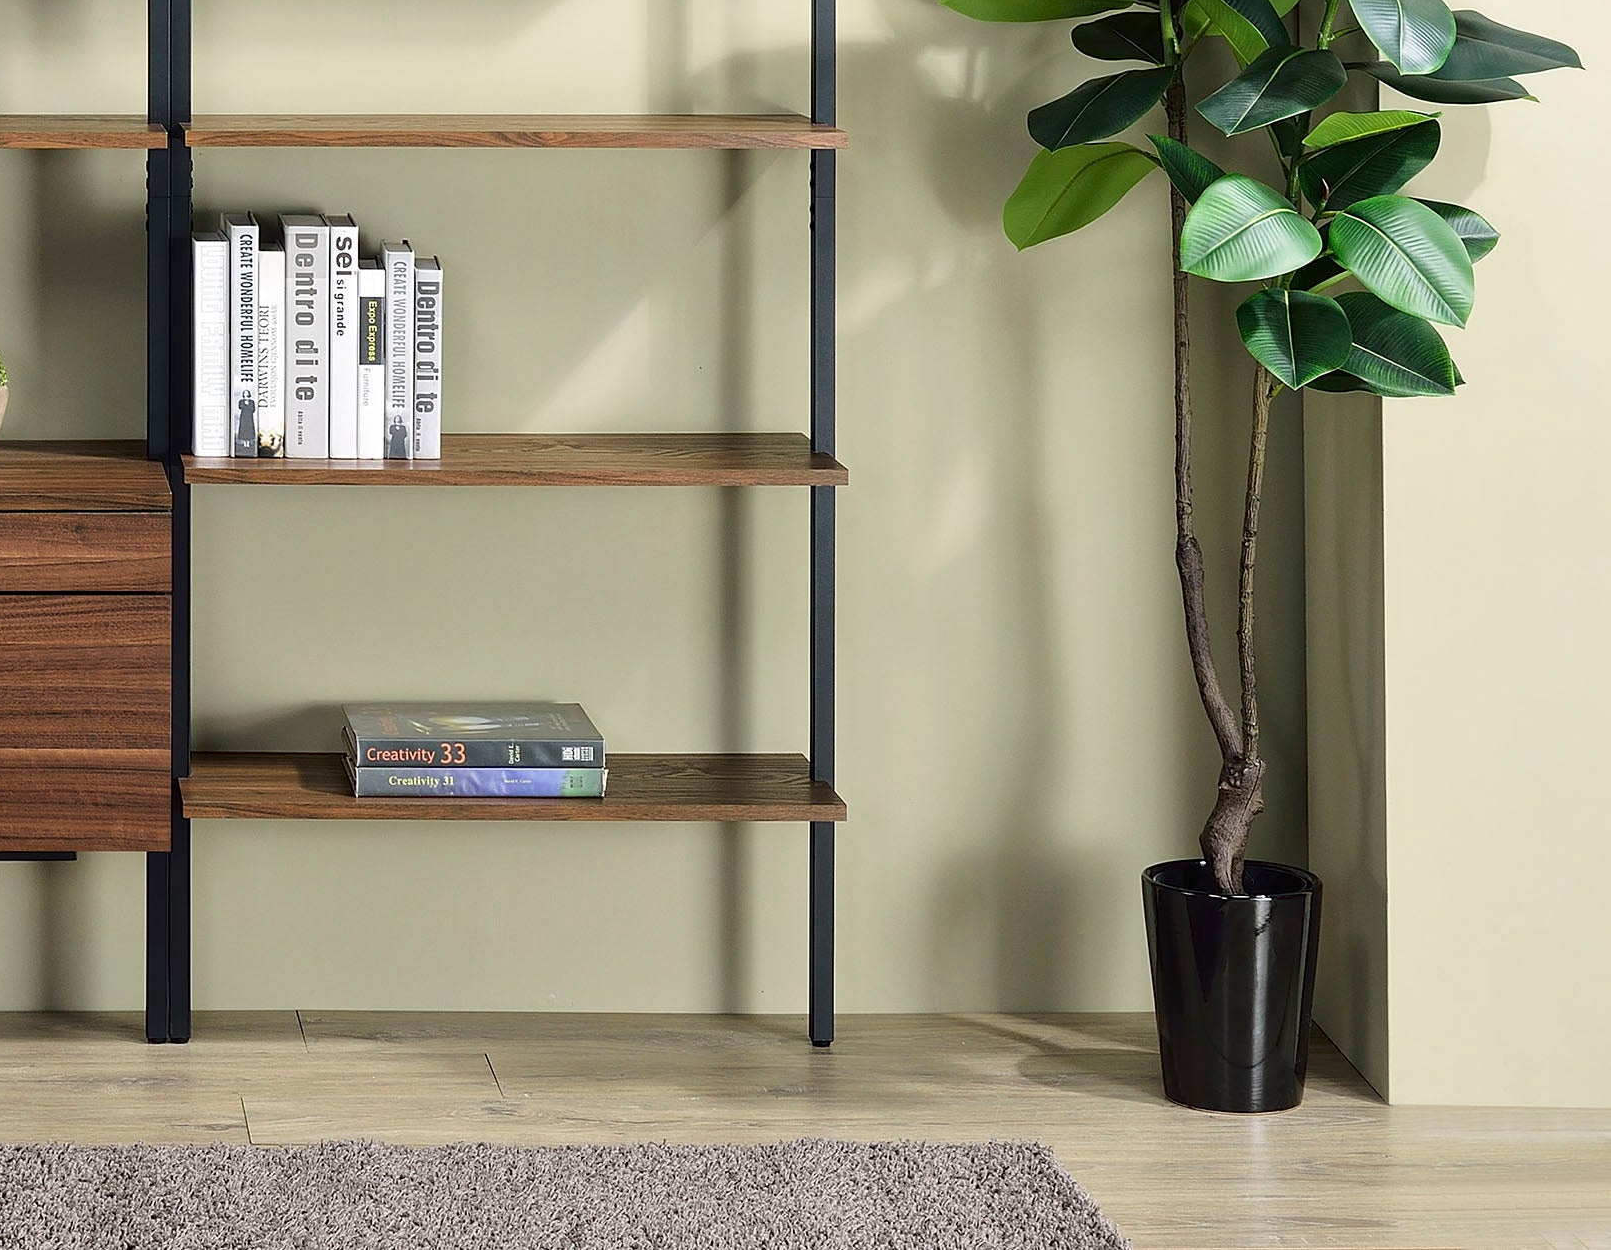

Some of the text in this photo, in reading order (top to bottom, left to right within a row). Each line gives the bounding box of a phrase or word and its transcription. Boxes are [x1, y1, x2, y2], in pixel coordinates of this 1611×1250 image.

[239, 233, 254, 383] CREATE WONDERFUL HOMELIFE
[334, 293, 346, 337] grande
[336, 278, 347, 290] si
[294, 232, 319, 401] Dentro di te
[367, 300, 377, 362] Expo Express
[391, 261, 408, 409] CREATE WONDERFUL HOMELIFE
[415, 281, 440, 414] Dentro di te
[258, 305, 270, 409] DARWINS TEORI
[362, 367, 371, 407] Furniture
[366, 742, 466, 765] Creativity 33
[388, 775, 455, 788] Creativity 31
